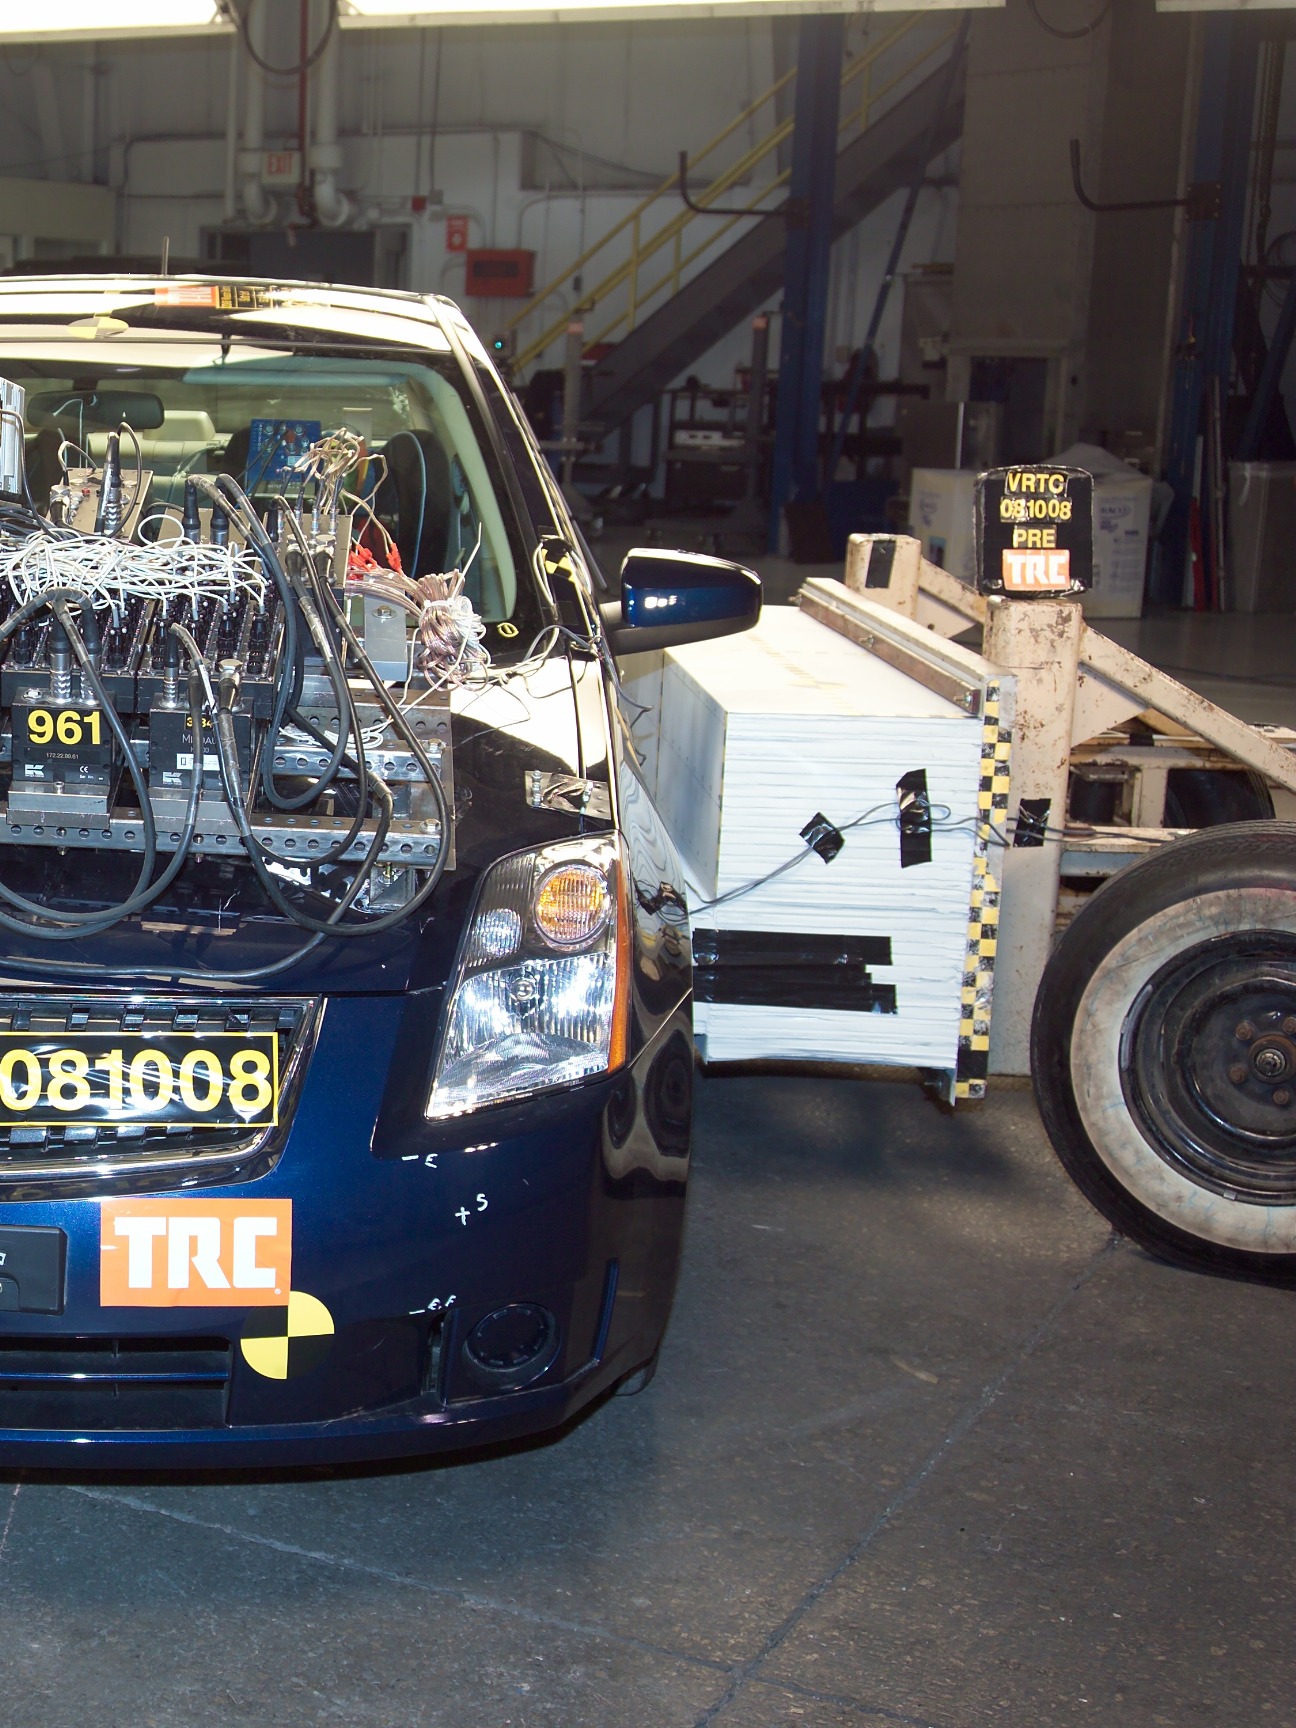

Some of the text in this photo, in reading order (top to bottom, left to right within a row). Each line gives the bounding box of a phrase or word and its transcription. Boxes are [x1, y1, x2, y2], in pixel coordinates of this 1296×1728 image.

[267, 153, 294, 176] EXIT
[1008, 473, 1064, 494] VRTC
[1001, 499, 1072, 520] 081008
[1015, 529, 1056, 548] PRE
[1007, 555, 1066, 585] TRC
[27, 709, 101, 745] 961
[114, 1216, 277, 1288] TRC
